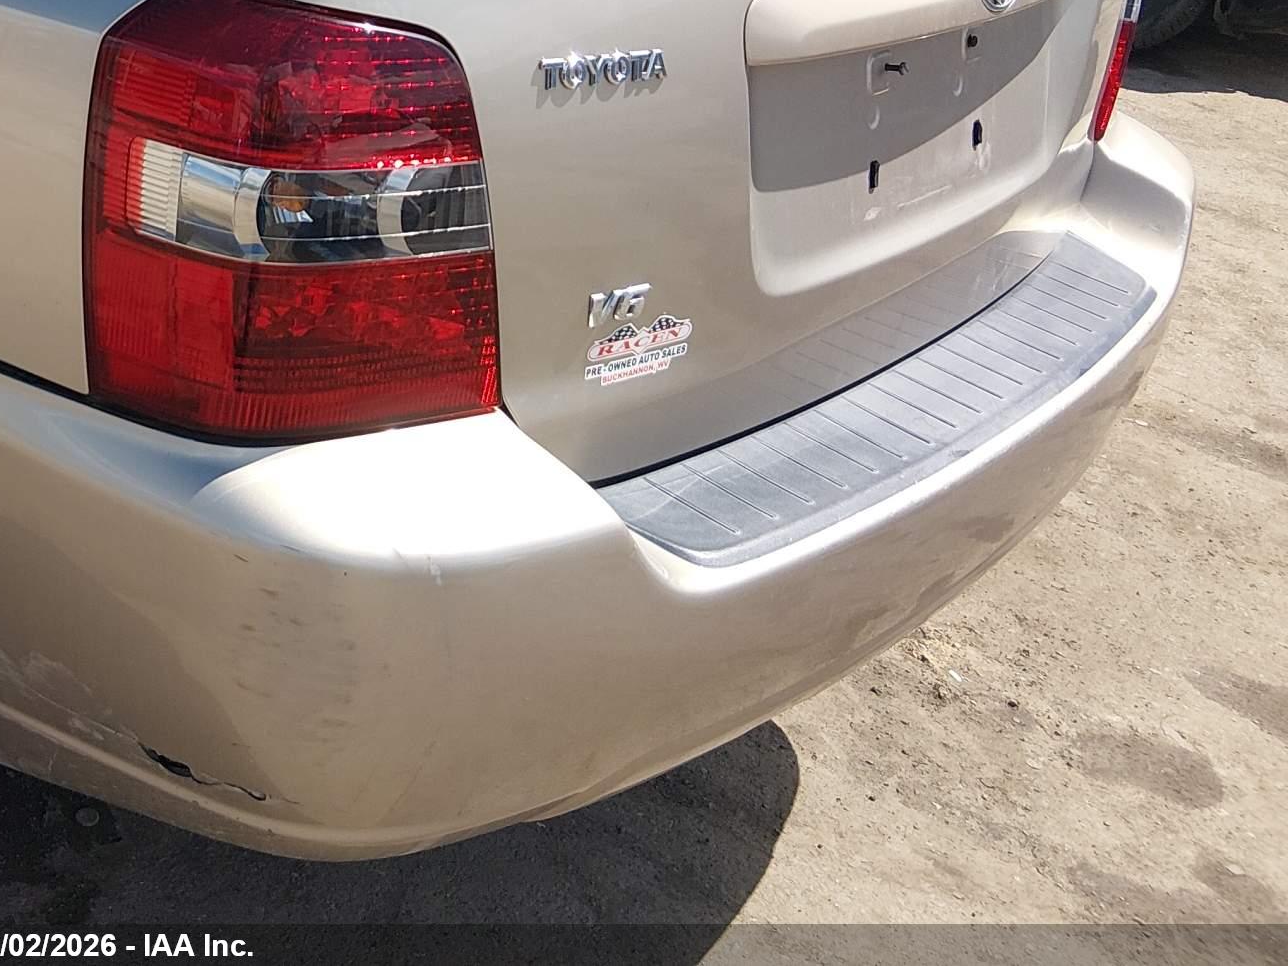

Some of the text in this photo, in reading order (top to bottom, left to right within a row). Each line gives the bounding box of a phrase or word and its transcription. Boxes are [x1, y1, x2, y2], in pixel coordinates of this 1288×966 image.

[539, 48, 667, 90] TOYOTA
[588, 283, 652, 328] V6
[638, 352, 660, 365] AUTO
[661, 344, 686, 359] SALES
